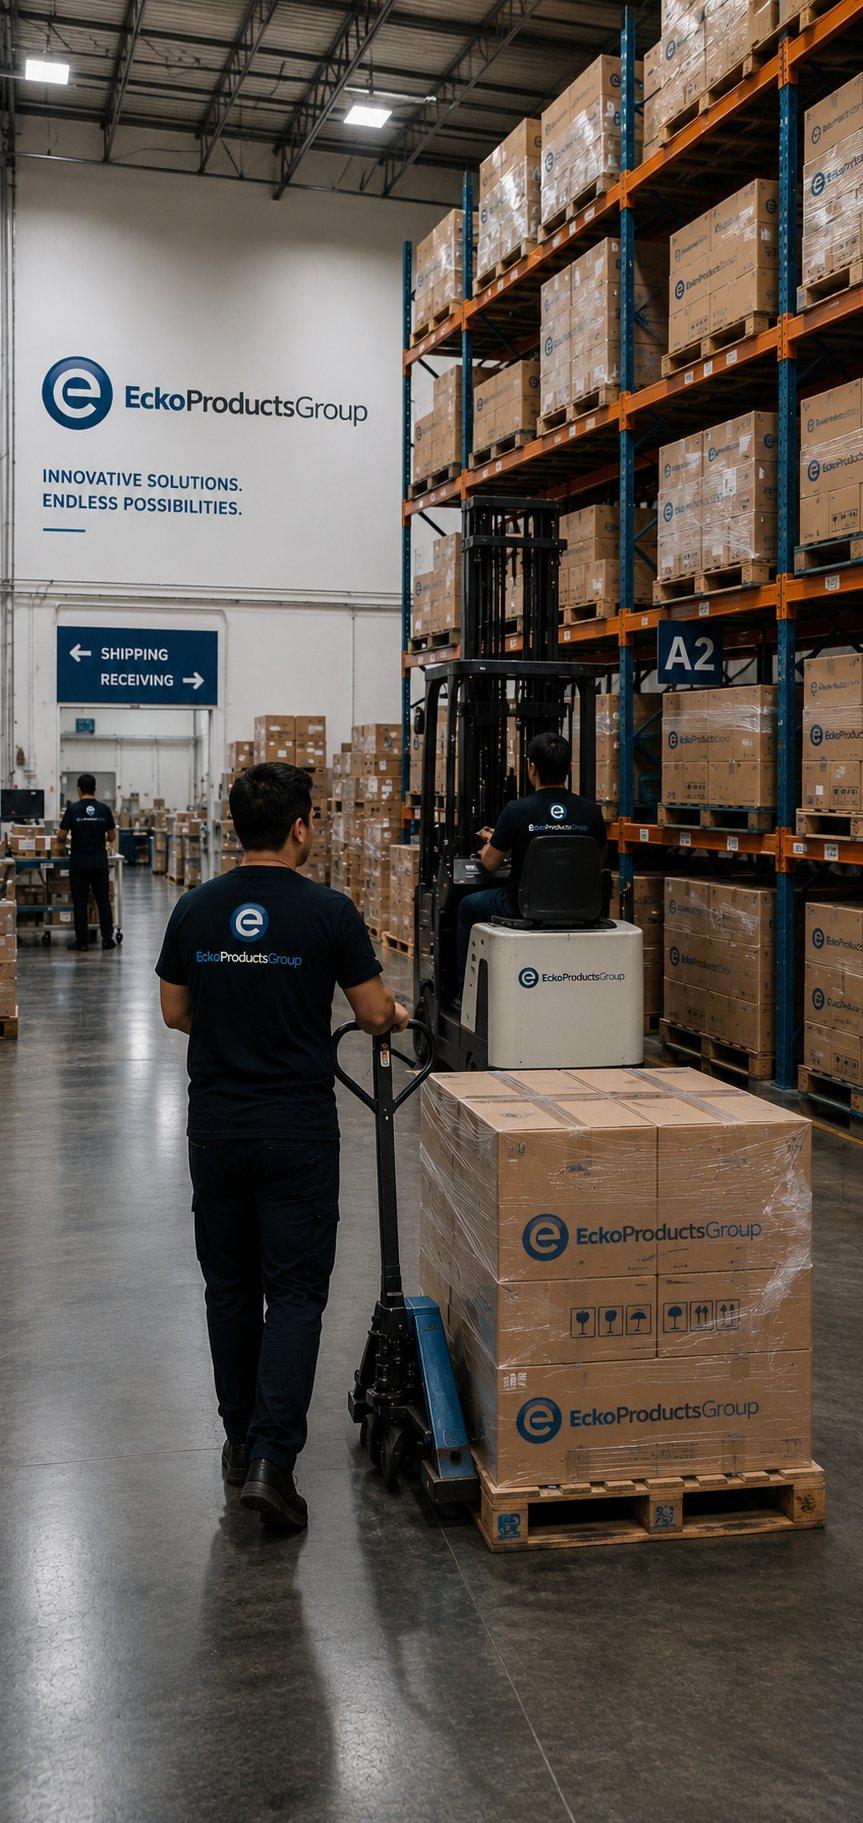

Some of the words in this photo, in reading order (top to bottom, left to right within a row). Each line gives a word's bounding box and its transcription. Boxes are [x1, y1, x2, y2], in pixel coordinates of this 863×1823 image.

[125, 386, 368, 427] EckoProductsGroup
[43, 469, 142, 487] INNOVATIVE
[147, 473, 242, 492] SOLUTIONS.
[43, 493, 118, 510] ENDLESS
[123, 496, 242, 516] POSSIBILITIES.
[101, 647, 168, 661] SHIPPING
[664, 636, 715, 671] A2
[100, 673, 174, 687] RECEIVING
[196, 951, 302, 969] EckoProductsGroup
[542, 972, 626, 983] EckoProductsGroup
[576, 1220, 762, 1246] EckoProductsGroup
[570, 1400, 759, 1429] EckoProductsGroup
